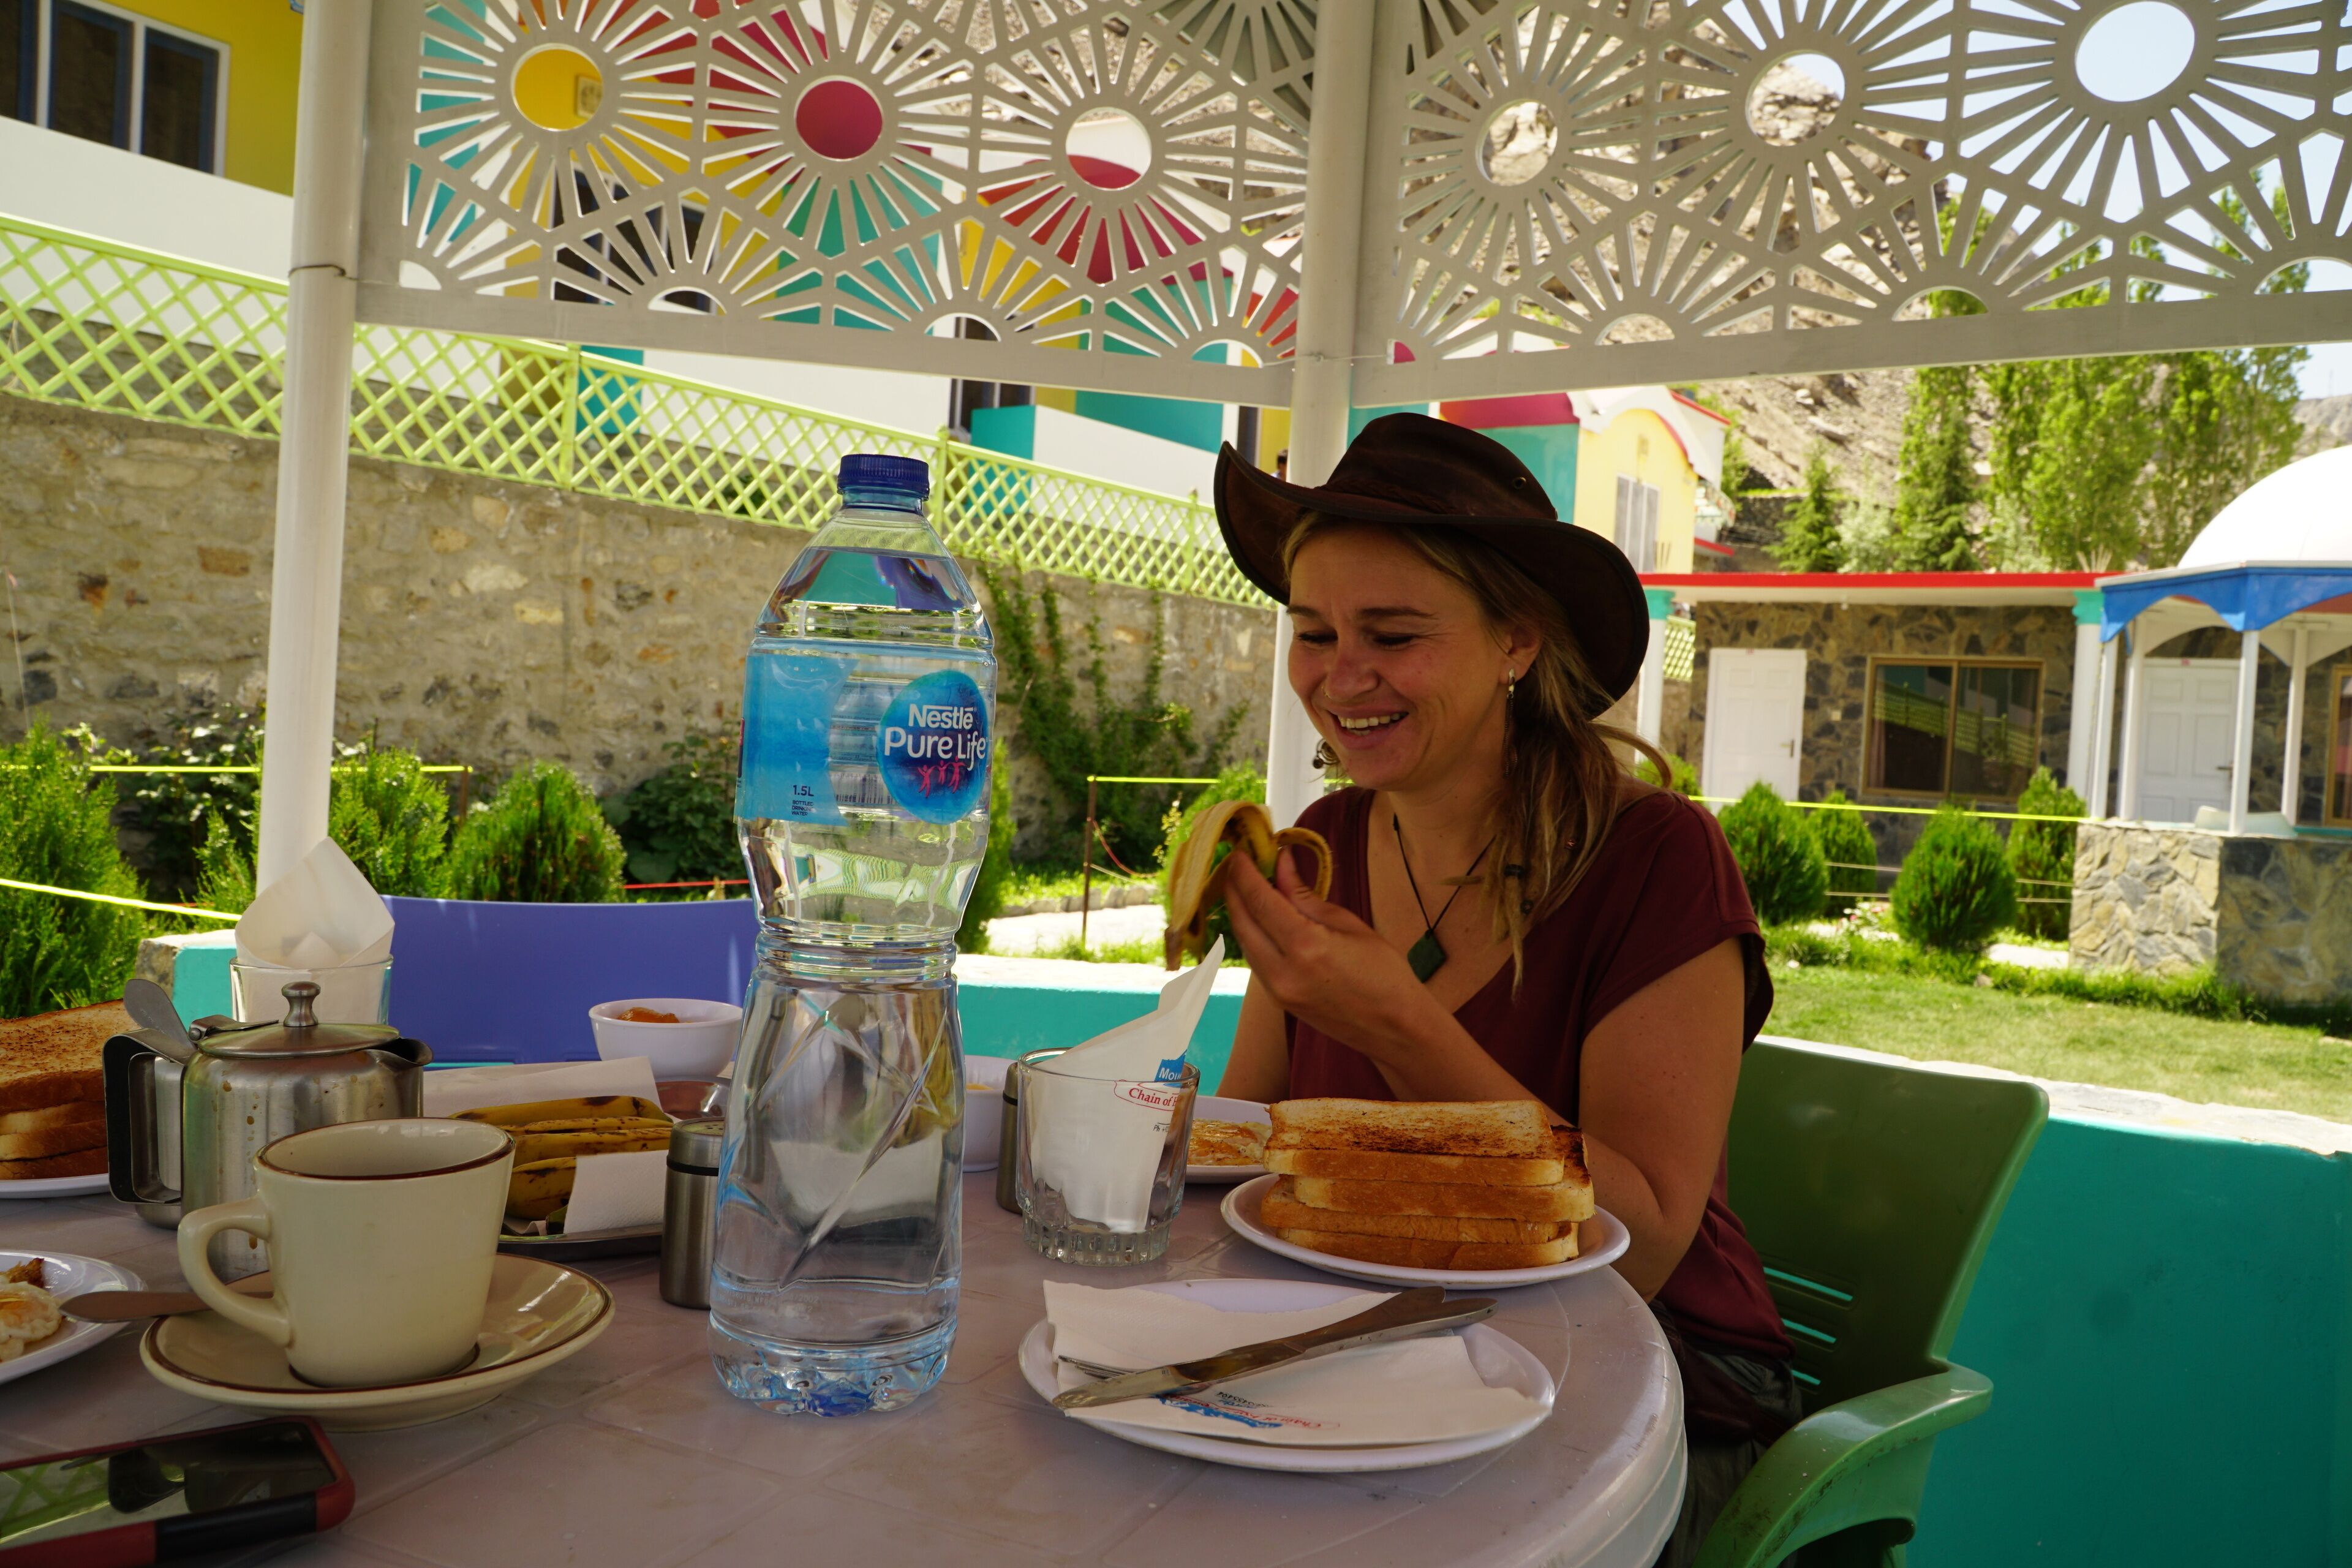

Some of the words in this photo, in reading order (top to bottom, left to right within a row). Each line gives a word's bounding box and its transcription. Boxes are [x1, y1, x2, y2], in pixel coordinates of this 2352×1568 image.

[908, 703, 974, 731] Nestlé
[883, 726, 954, 760] Pure
[957, 731, 987, 772] Life
[793, 785, 815, 797] 1.5L
[1128, 1087, 1161, 1105] Chain
[1163, 1096, 1173, 1107] of
[1153, 1124, 1160, 1133] Ph
